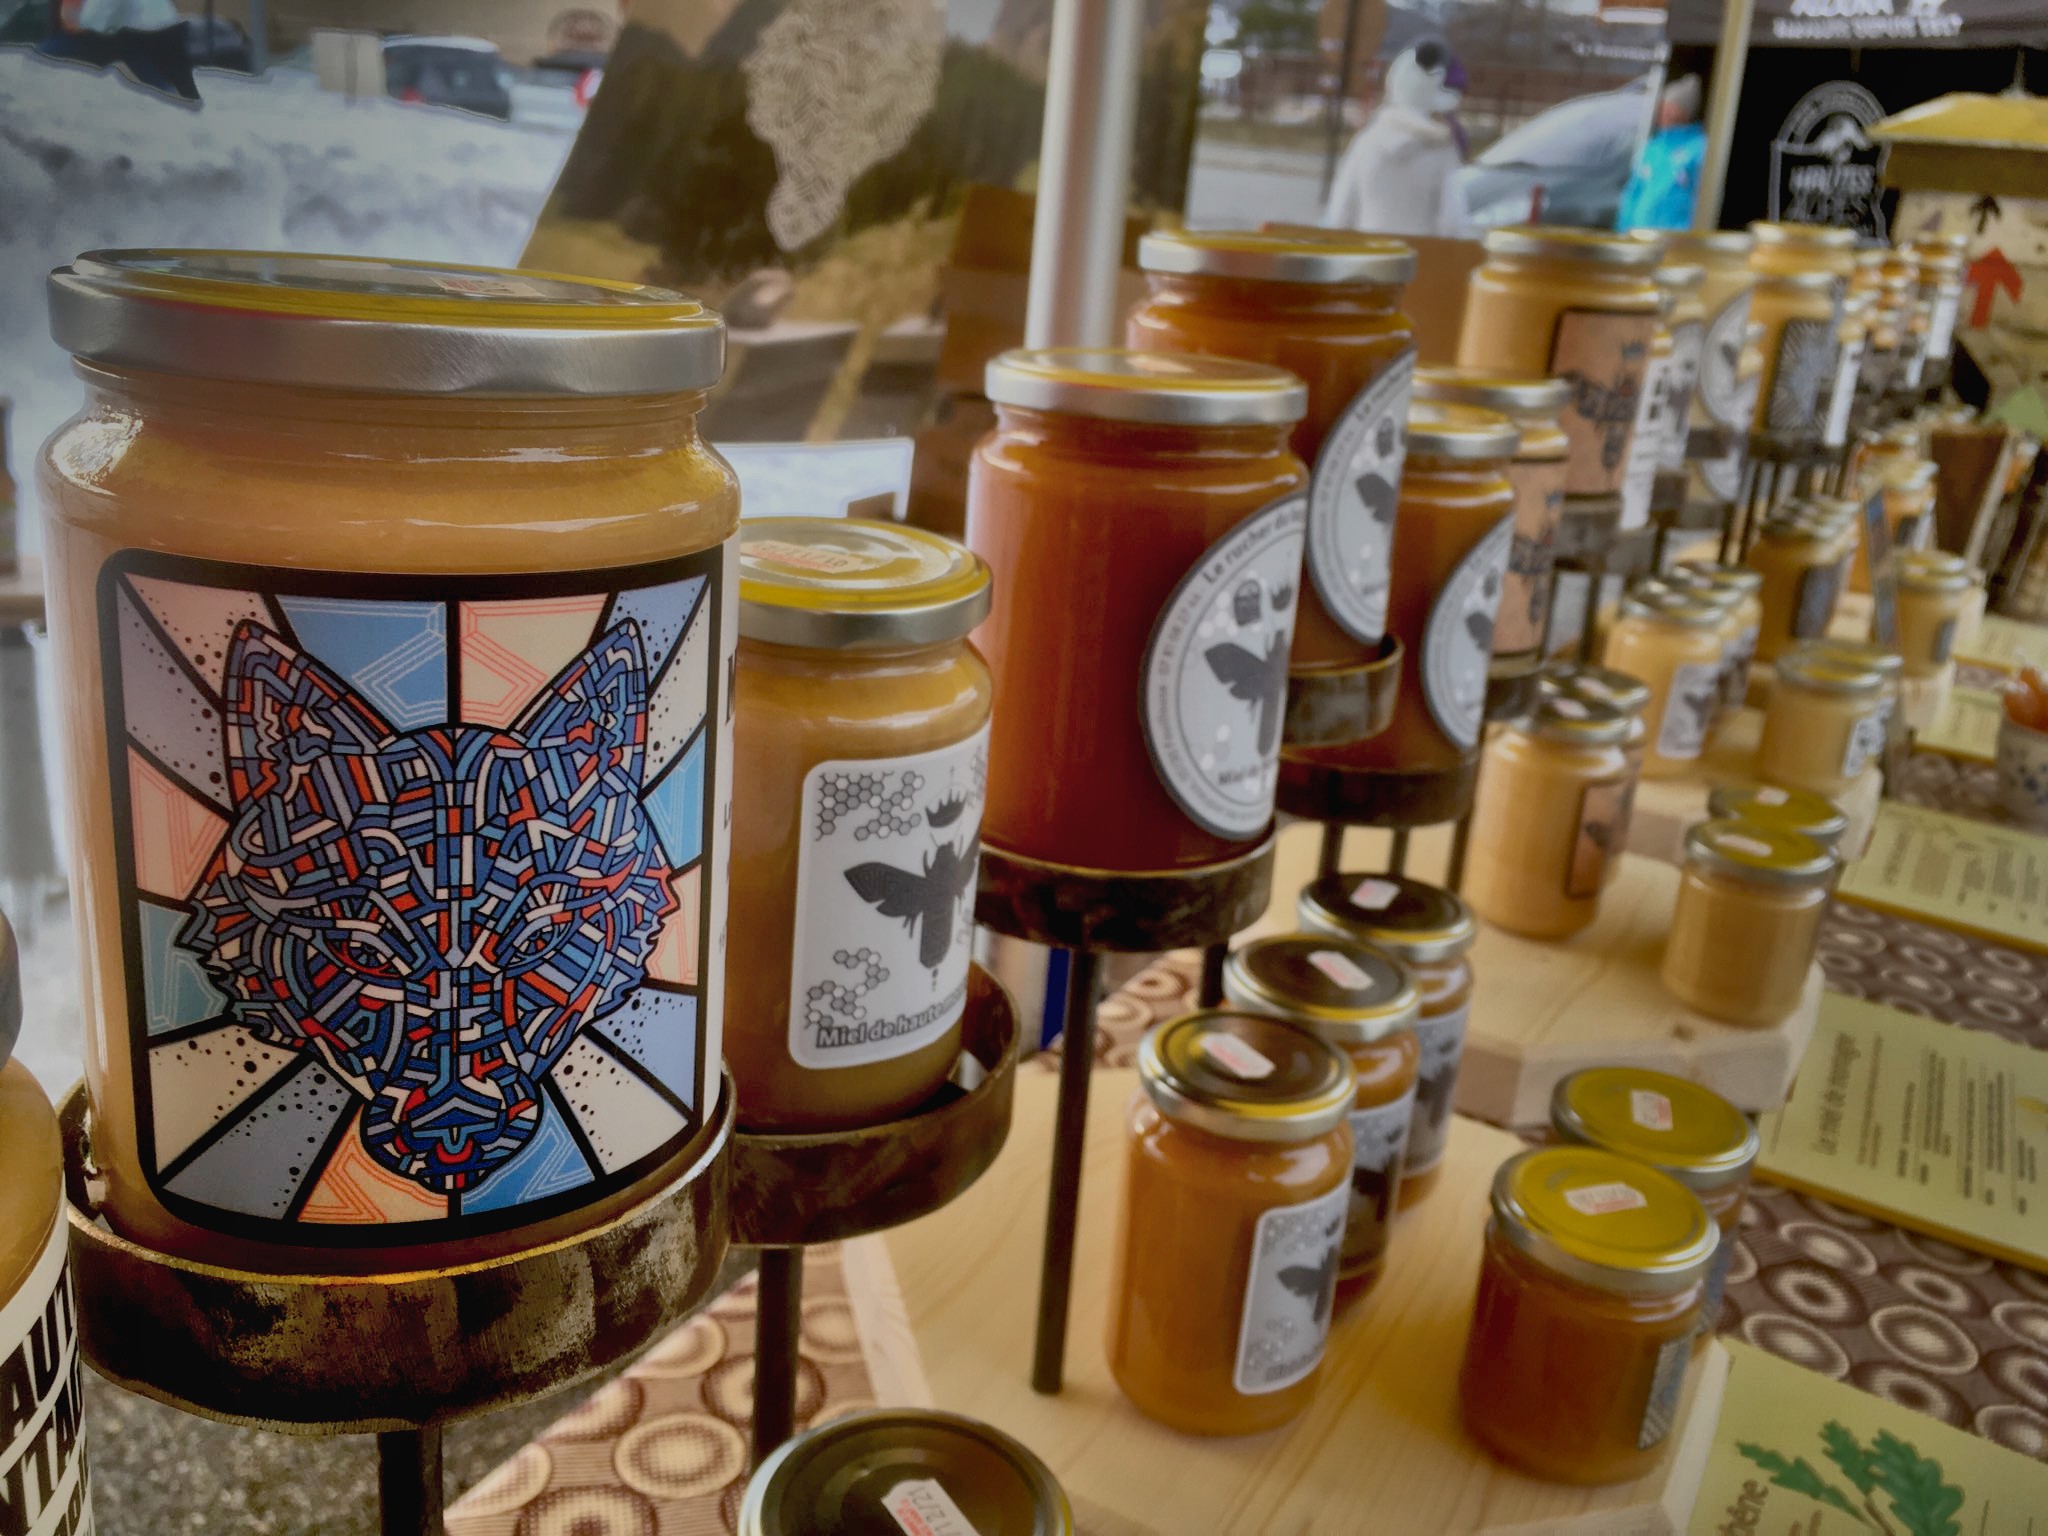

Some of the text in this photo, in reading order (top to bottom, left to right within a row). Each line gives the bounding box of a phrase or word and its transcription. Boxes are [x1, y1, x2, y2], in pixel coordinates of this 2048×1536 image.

[1203, 562, 1224, 583] Le
[816, 1023, 867, 1049] Miel
[869, 1018, 895, 1043] de
